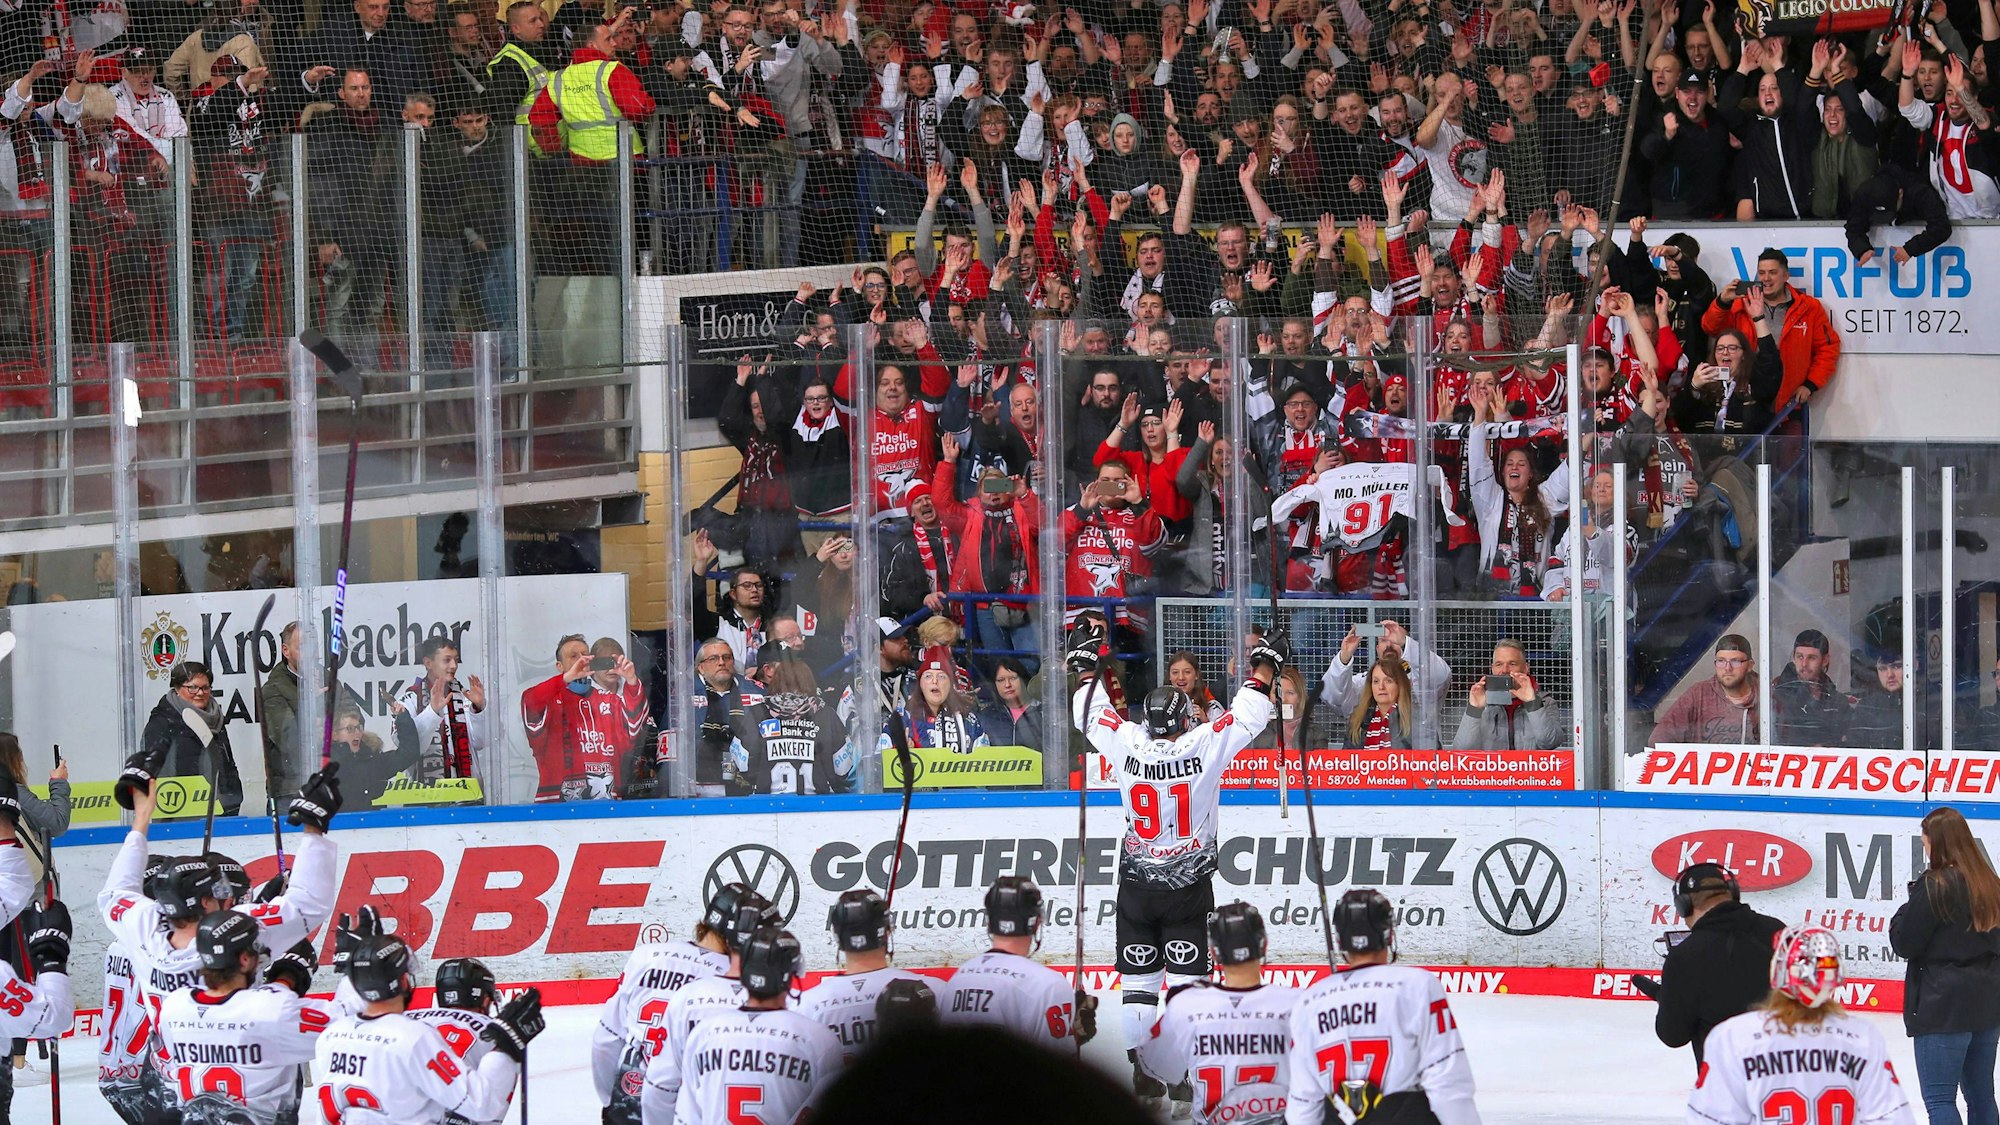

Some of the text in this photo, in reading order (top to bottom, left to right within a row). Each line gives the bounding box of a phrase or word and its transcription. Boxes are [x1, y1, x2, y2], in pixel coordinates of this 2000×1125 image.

[1779, 0, 1826, 20] LEGIO
[697, 303, 757, 341] Horn
[759, 300, 780, 337] &
[1845, 310, 1899, 333] SEIT
[1905, 309, 1968, 334] 1872.
[871, 438, 918, 455] Energie
[1334, 481, 1409, 500] MO. MÜLLER
[1342, 493, 1394, 536] 91
[804, 612, 815, 630] B
[781, 728, 803, 737] Bank
[771, 741, 811, 758] ANKERT
[929, 759, 1033, 774] WARRIOR
[1123, 755, 1142, 777] MO.
[1144, 756, 1203, 781] MÜLLER
[1308, 753, 1454, 775] Metallgroßhandel
[1457, 753, 1562, 772] Krabbenhöft
[770, 761, 817, 795] 91
[1327, 774, 1361, 786] 58706
[1366, 774, 1407, 786] Menden
[1128, 780, 1194, 842] 91
[174, 862, 209, 873] STETSON
[218, 863, 243, 872] TETSON
[810, 835, 1458, 892] GOTTFRIE CHULTZ
[243, 839, 667, 966] BBE
[211, 914, 244, 939] STETSON
[951, 988, 994, 1013] DIETZ
[1317, 1001, 1377, 1034] ROACH
[172, 1042, 262, 1066] ATSUMOTO
[329, 1052, 367, 1078] BAST
[728, 1048, 813, 1083] CALSTER
[1743, 1048, 1867, 1082] PANTKOWSKI
[1314, 1036, 1394, 1101] 77
